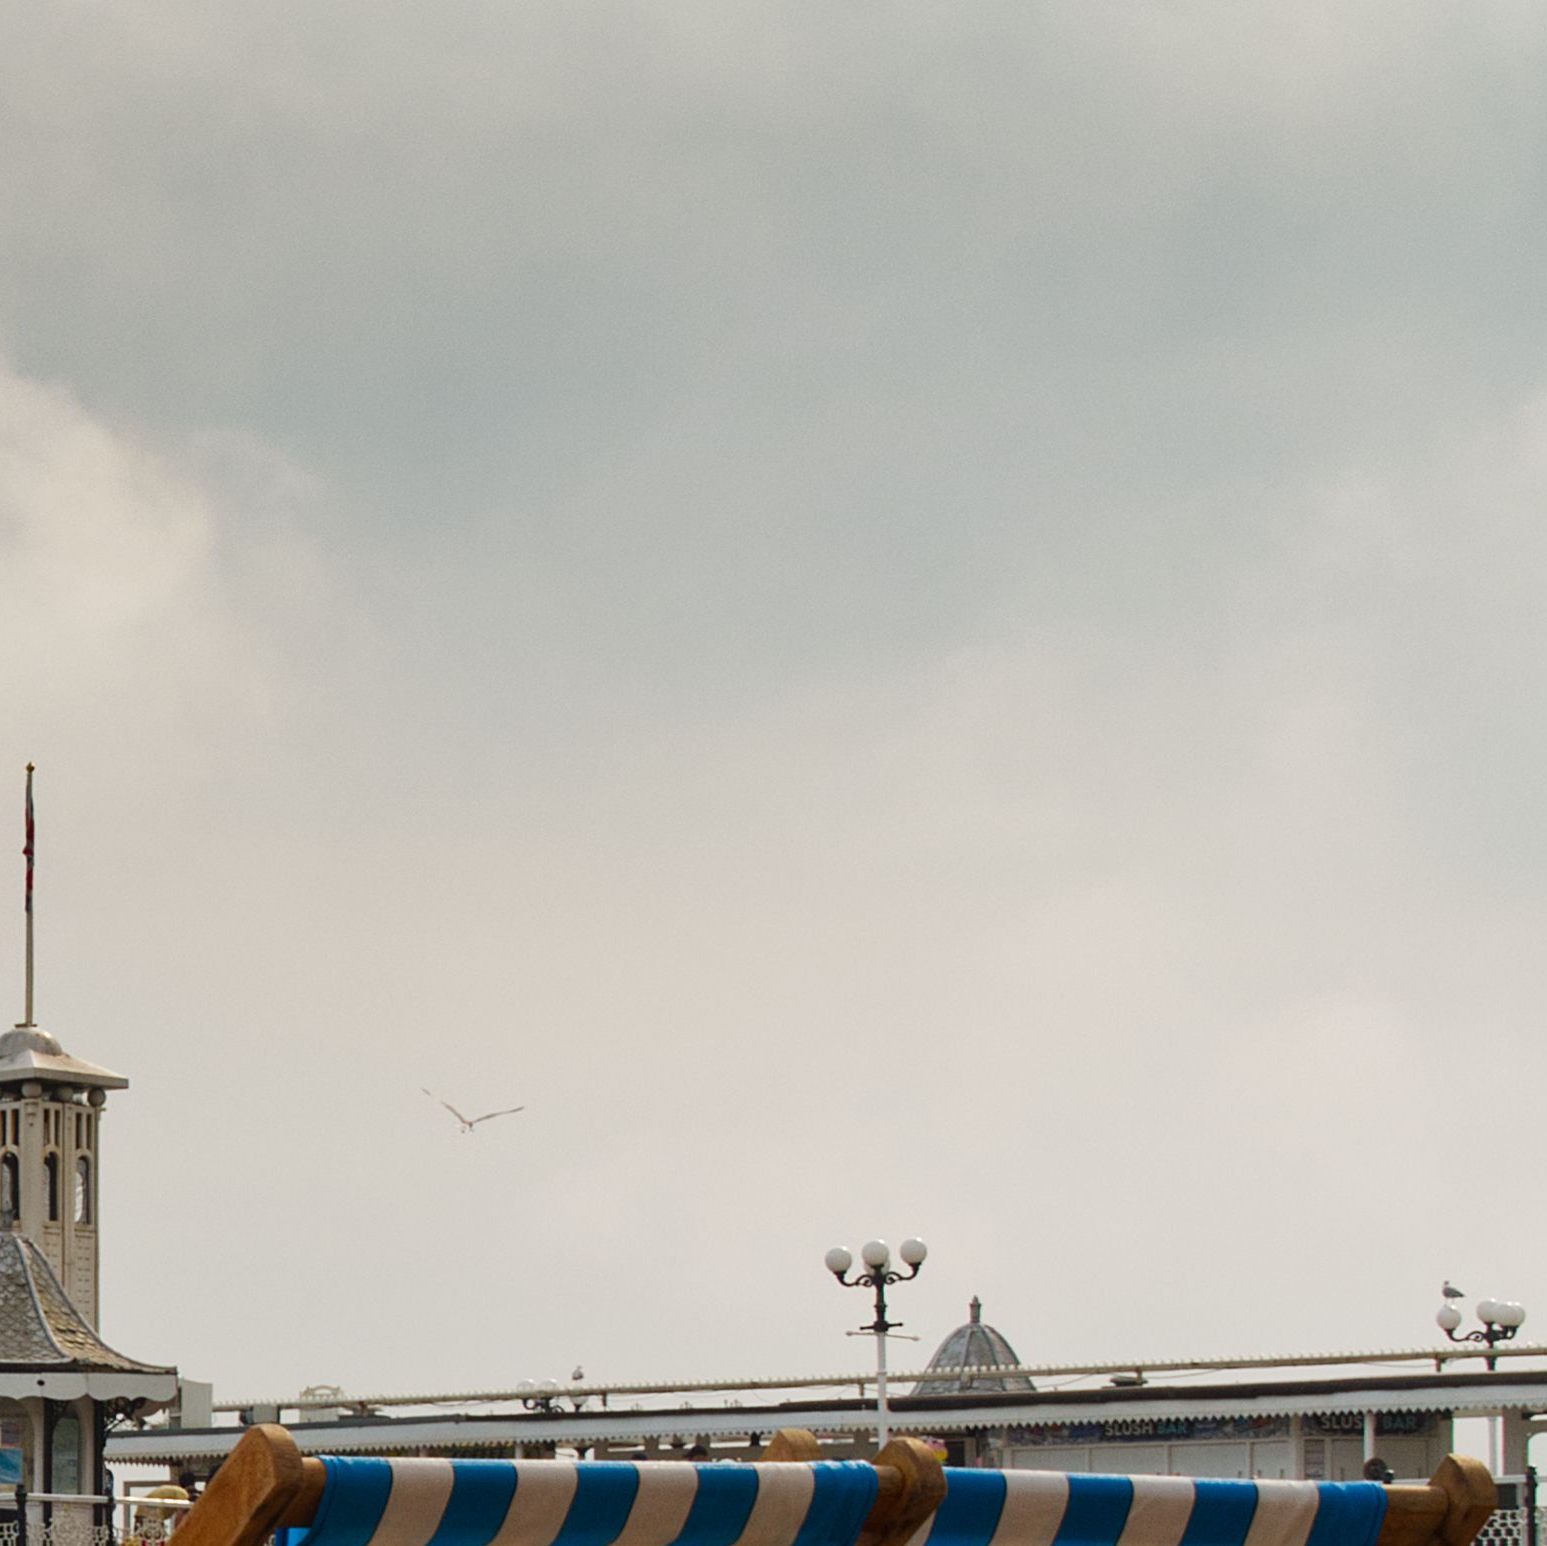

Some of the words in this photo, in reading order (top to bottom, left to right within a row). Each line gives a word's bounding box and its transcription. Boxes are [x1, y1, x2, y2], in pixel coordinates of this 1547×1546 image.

[1104, 1420, 1153, 1436] SLUSH
[1157, 1419, 1187, 1435] BAR
[1321, 1415, 1364, 1430] SLUS
[1381, 1415, 1416, 1430] BAR
